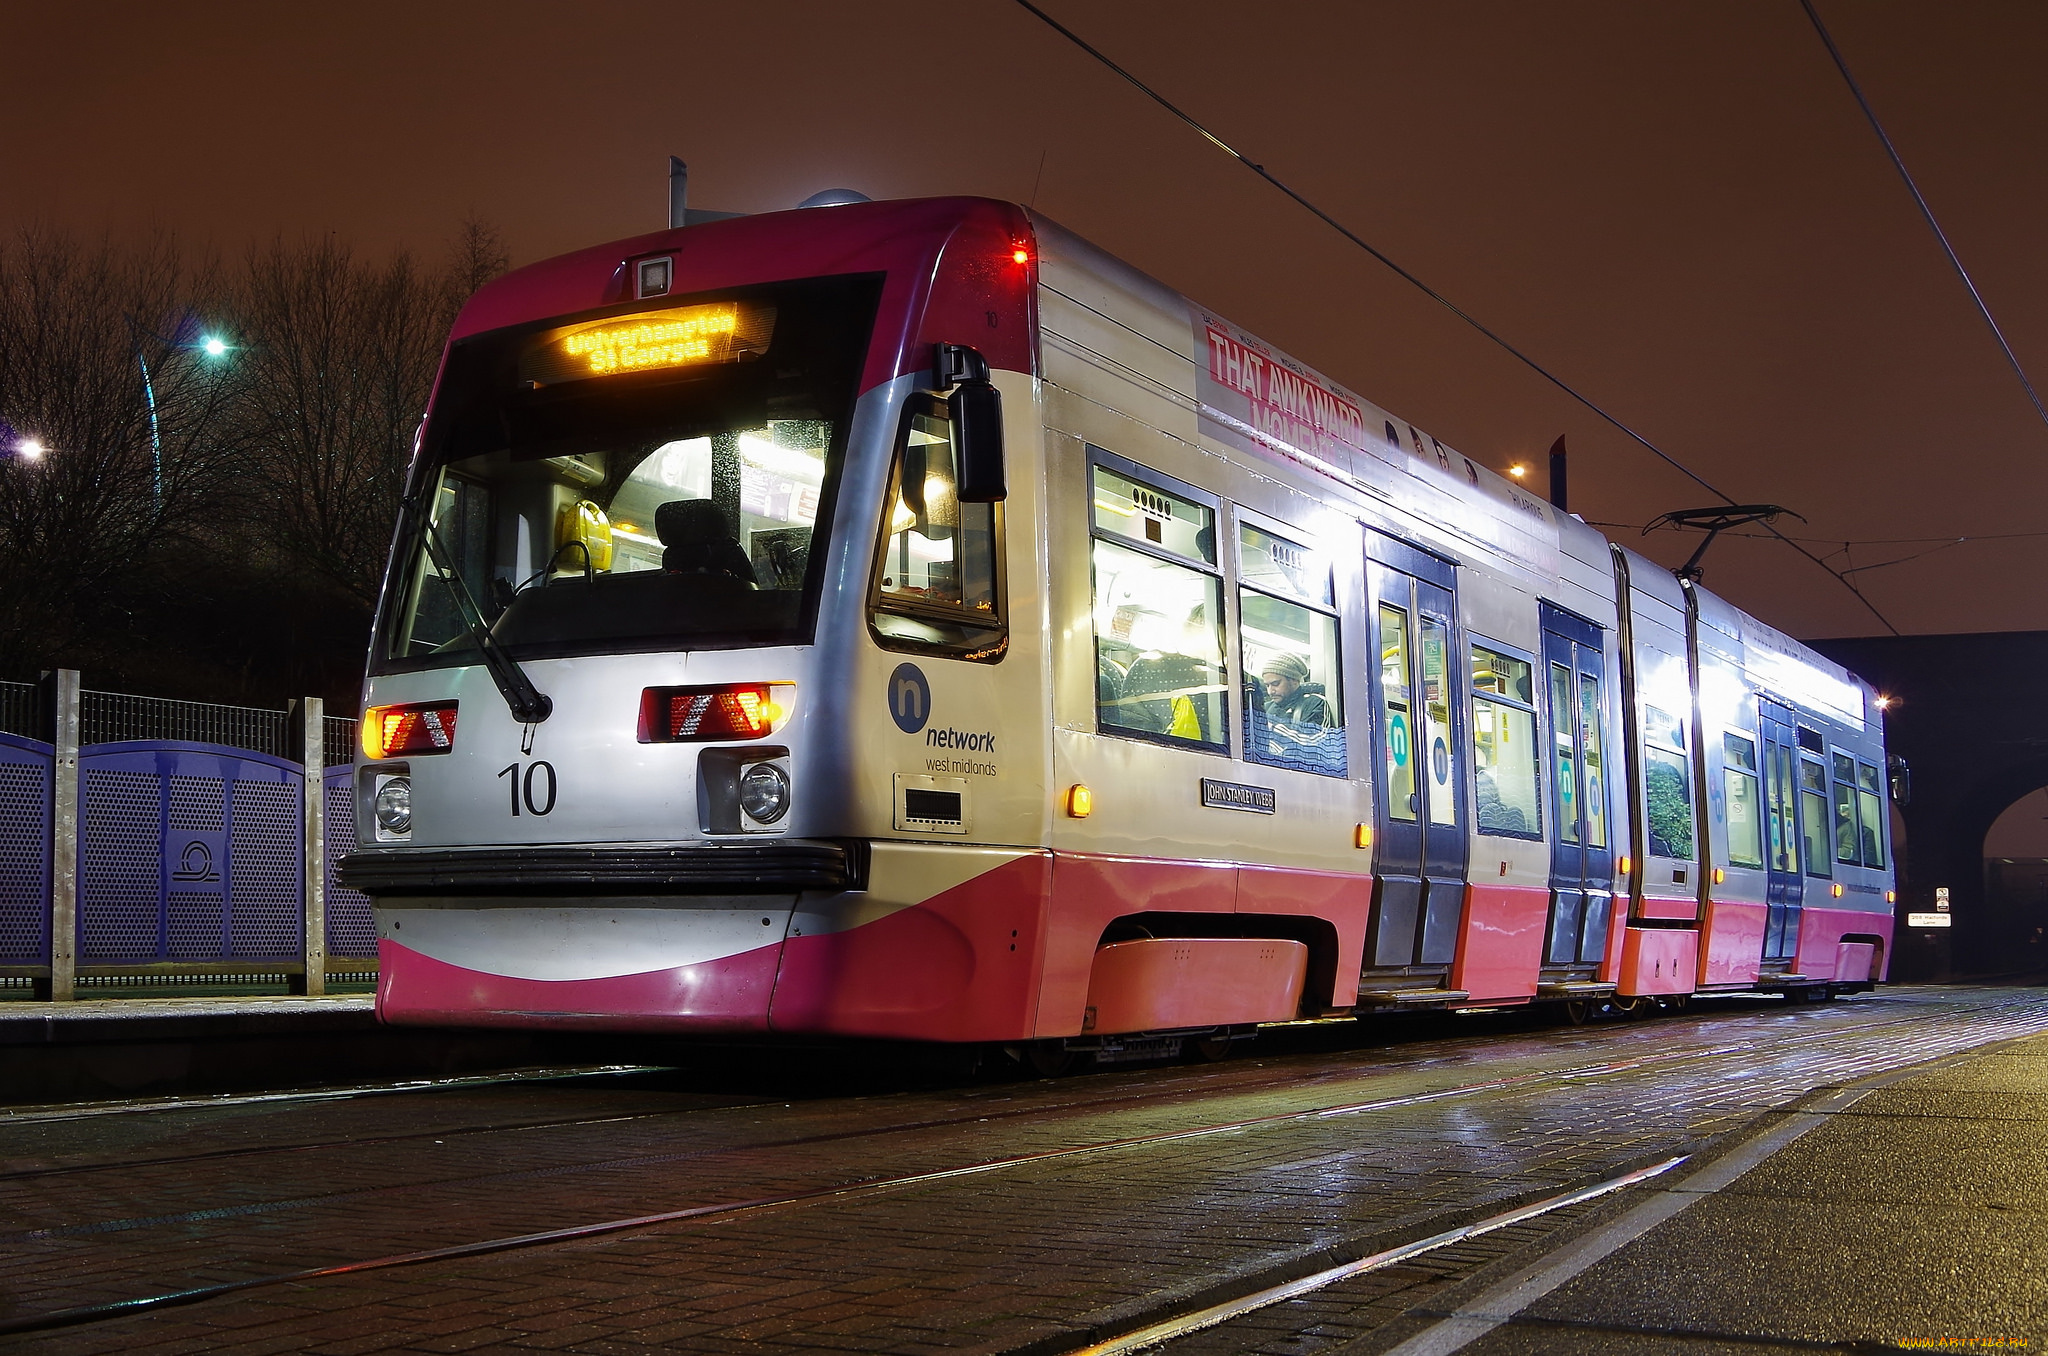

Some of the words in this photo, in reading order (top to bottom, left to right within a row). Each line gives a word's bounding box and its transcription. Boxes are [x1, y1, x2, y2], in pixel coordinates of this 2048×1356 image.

[985, 310, 998, 328] 10
[1209, 331, 1263, 401] THAT
[1268, 364, 1364, 448] AWKWARD
[898, 679, 922, 718] n
[926, 726, 996, 753] network
[925, 756, 950, 773] west
[952, 758, 997, 777] midlands
[497, 760, 557, 817] 10
[1206, 783, 1225, 802] JOHN
[1226, 787, 1254, 805] STANLEY
[1254, 791, 1274, 807] WEBB
